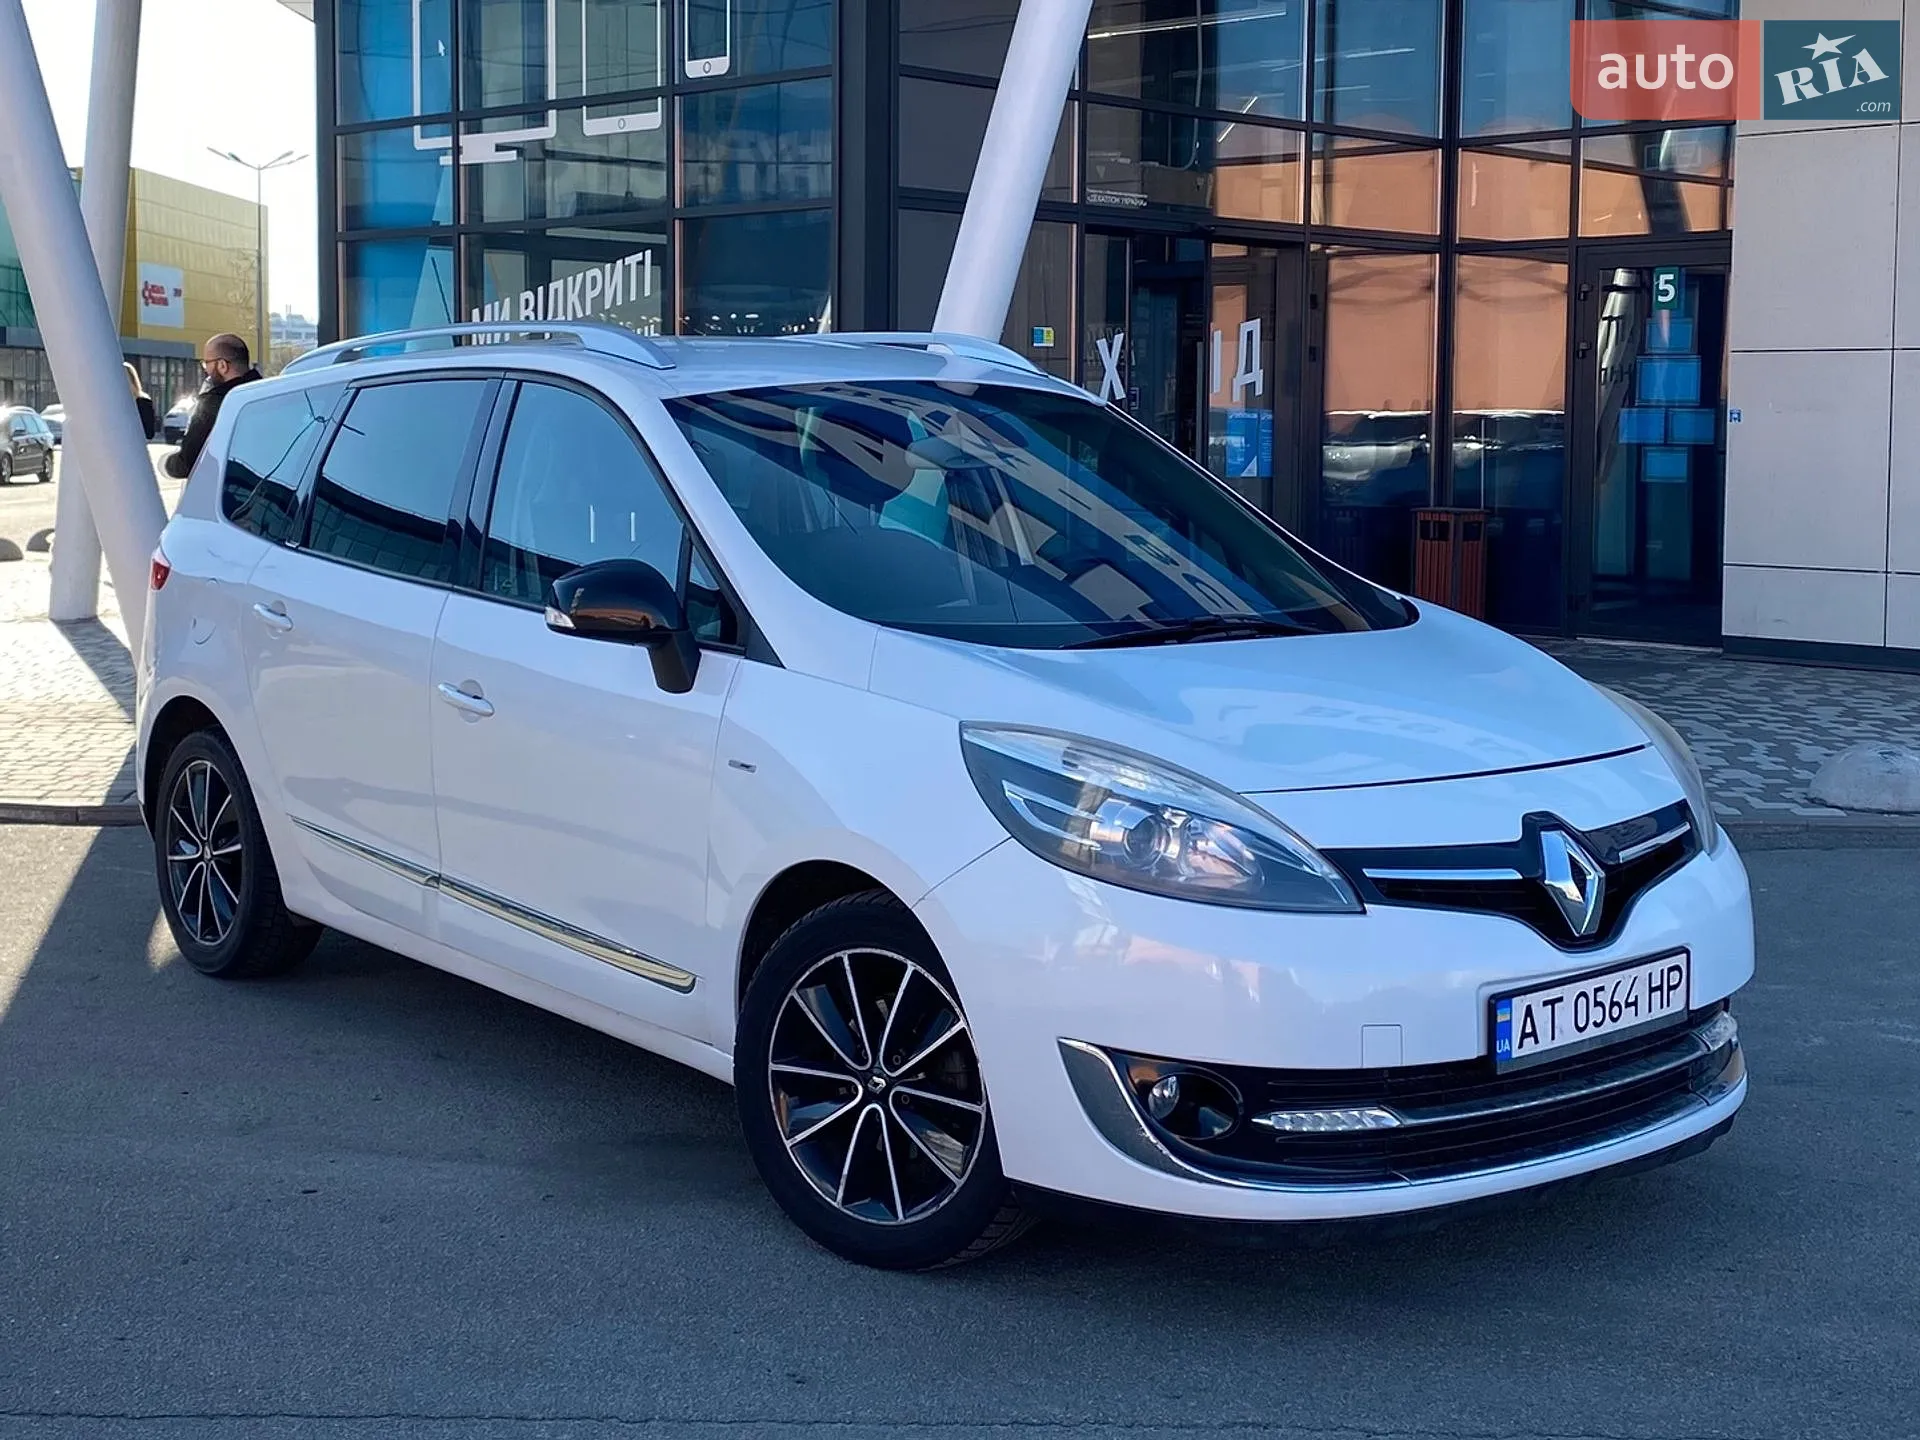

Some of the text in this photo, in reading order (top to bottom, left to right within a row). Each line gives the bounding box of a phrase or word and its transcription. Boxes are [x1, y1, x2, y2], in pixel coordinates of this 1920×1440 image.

[471, 249, 652, 346] МИ ВІДКРИТІ
[1656, 273, 1675, 303] 5
[1518, 964, 1684, 1050] AT 0564 HP
[1496, 1039, 1511, 1053] UA
